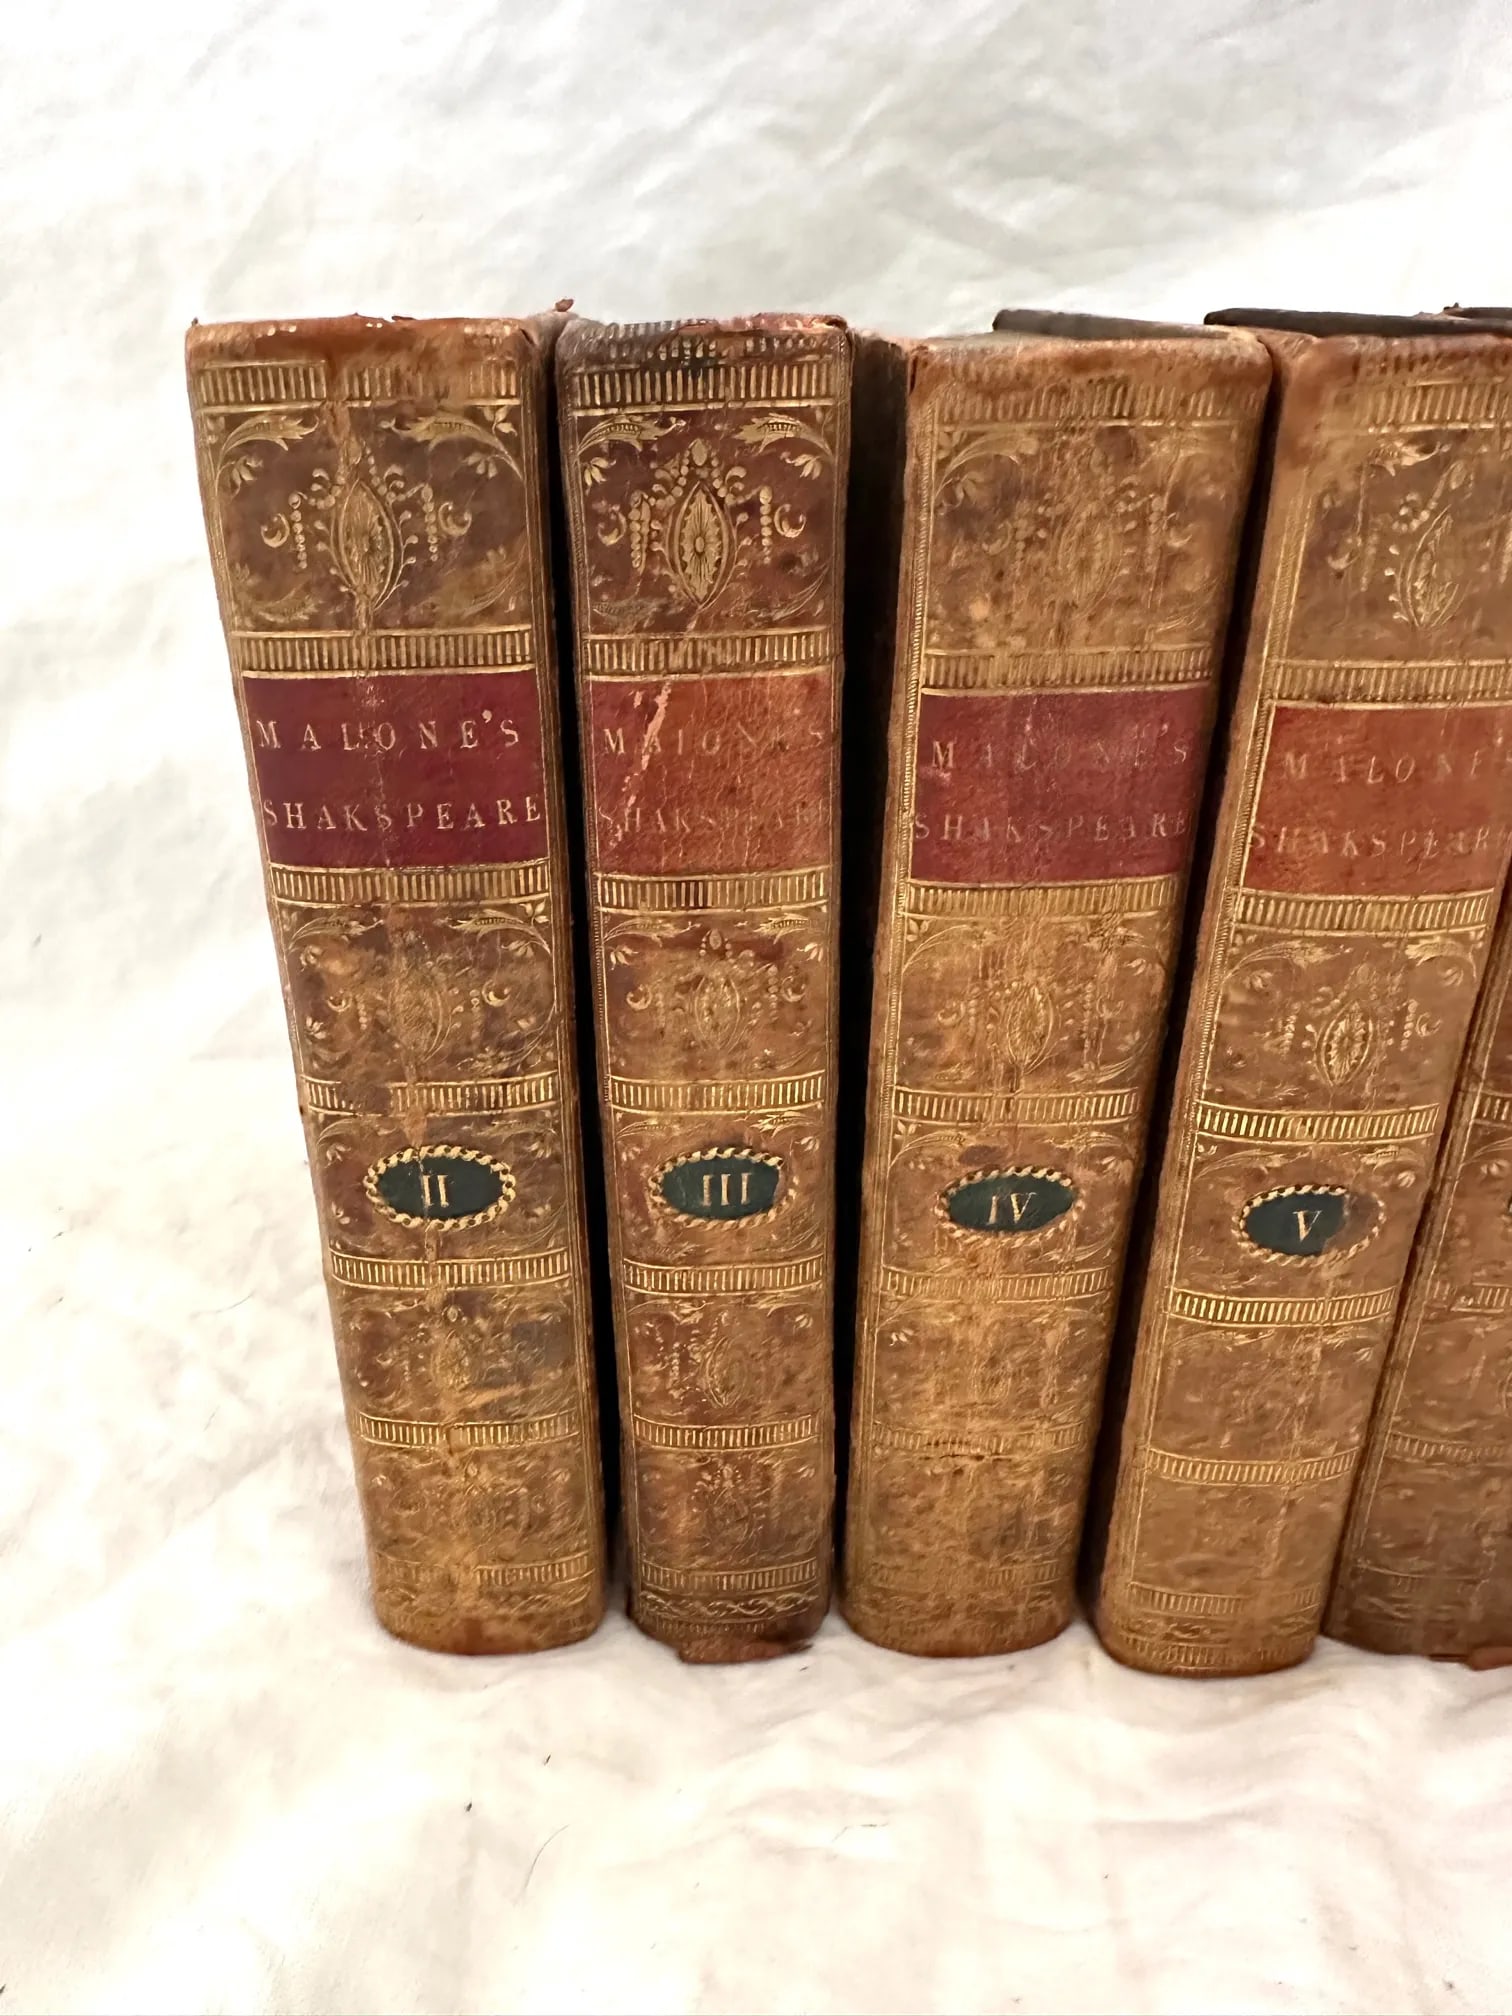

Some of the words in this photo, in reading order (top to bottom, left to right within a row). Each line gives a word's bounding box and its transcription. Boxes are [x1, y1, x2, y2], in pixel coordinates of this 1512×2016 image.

[262, 792, 541, 832] SHAKSPEARE
[598, 799, 828, 833] SHAKSP
[1250, 822, 1507, 859] SHAKSPEAR
[423, 1173, 450, 1207] II
[702, 1171, 752, 1206] III
[986, 1191, 1037, 1226] IV
[1293, 1209, 1322, 1241] V
